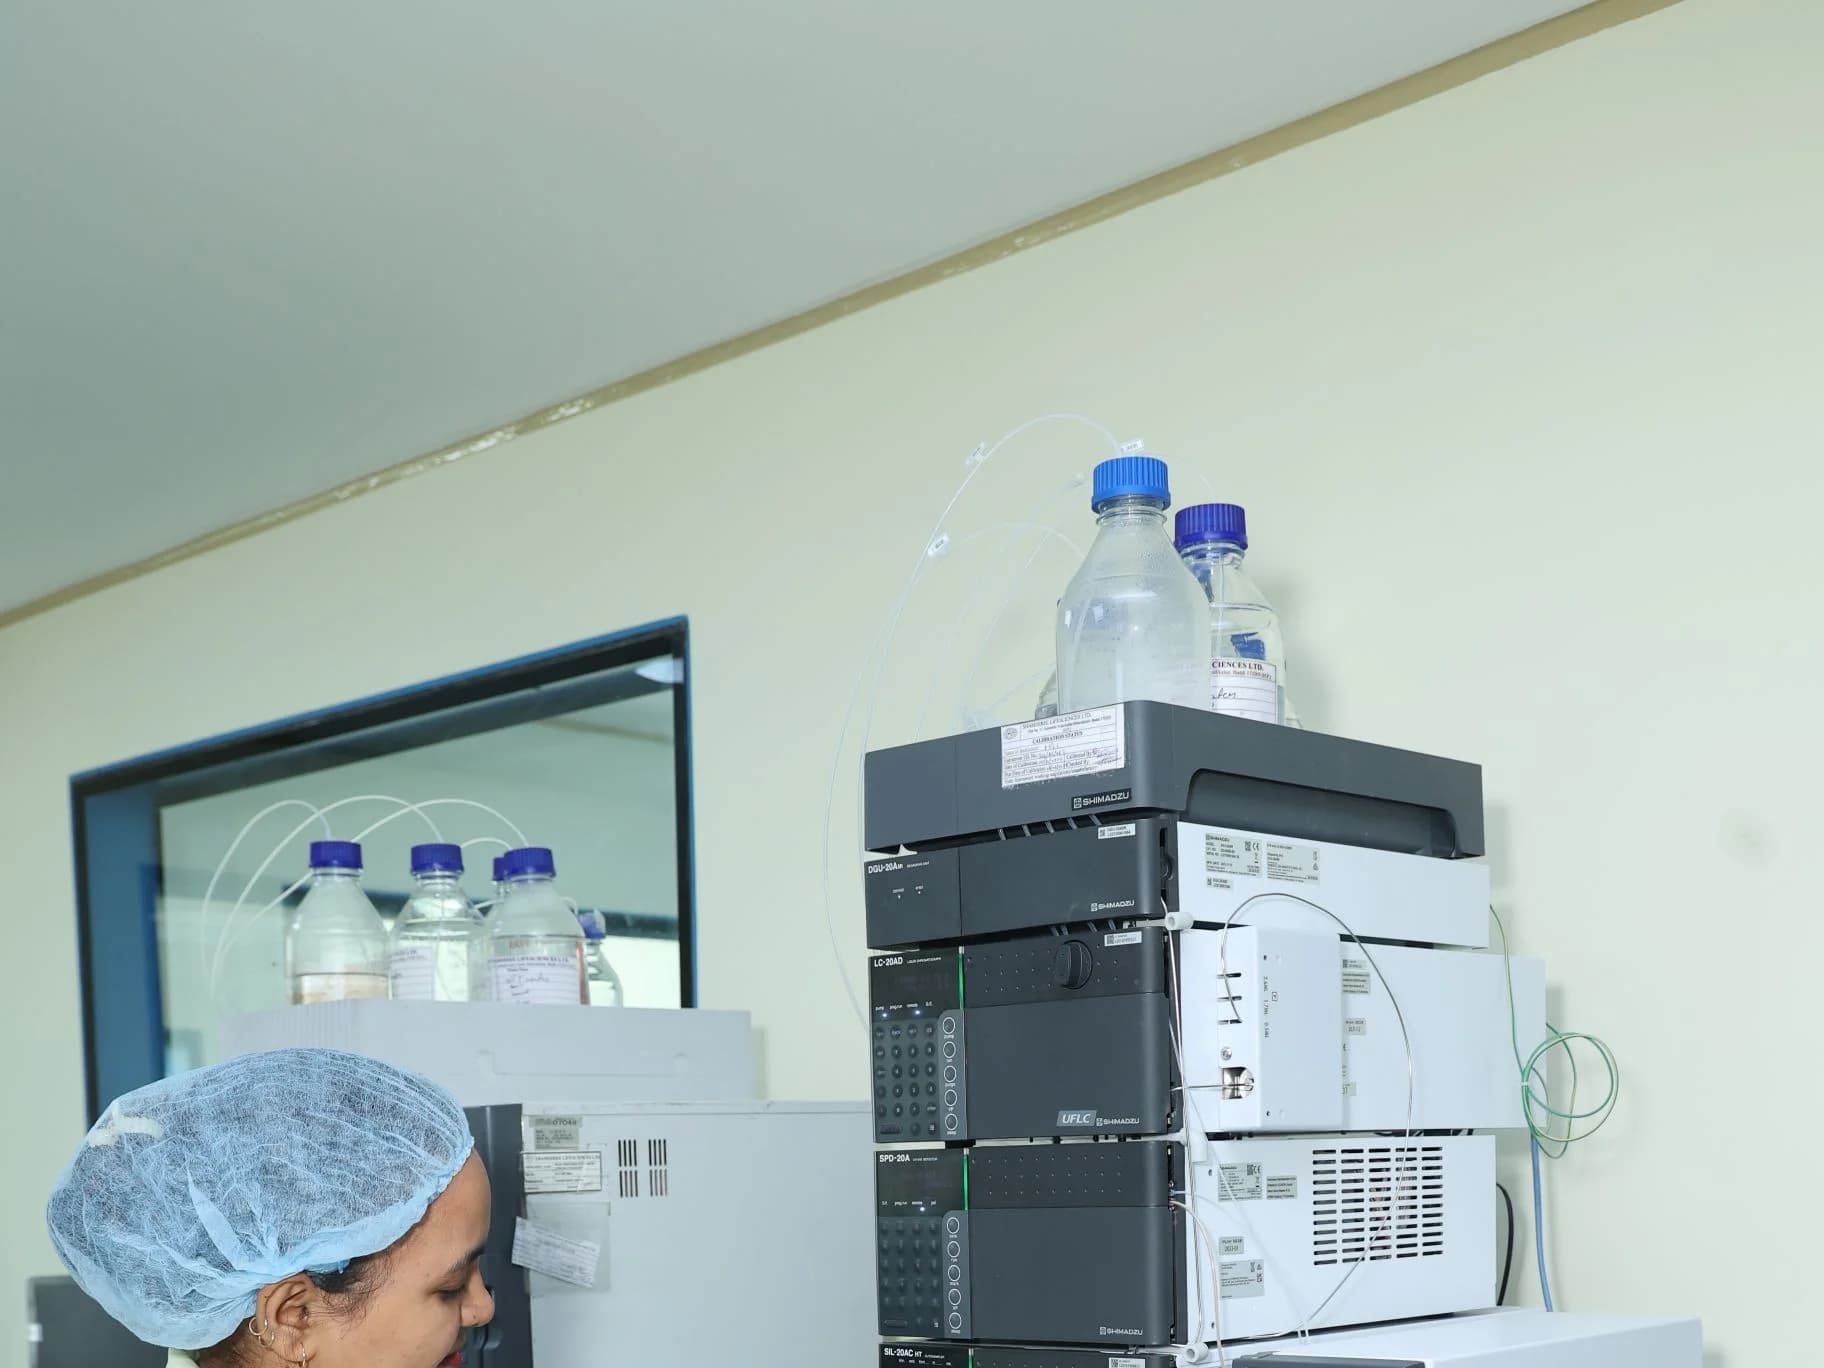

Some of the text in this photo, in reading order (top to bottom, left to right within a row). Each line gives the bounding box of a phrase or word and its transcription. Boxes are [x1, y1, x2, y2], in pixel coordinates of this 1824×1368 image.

[1211, 660, 1264, 671] CIENCES LTD.
[1032, 730, 1084, 744] CALIBRATION STATUS
[1082, 791, 1130, 806] SHIMADZU
[1098, 899, 1135, 910] SHIMADZU
[874, 956, 904, 968] LC-20AD
[1062, 1113, 1140, 1125] UFLC SHIMADZU
[880, 1153, 910, 1162] SPD-20A
[1107, 1327, 1143, 1336] SHIMADZU
[884, 1347, 914, 1357] SIL-20AC
